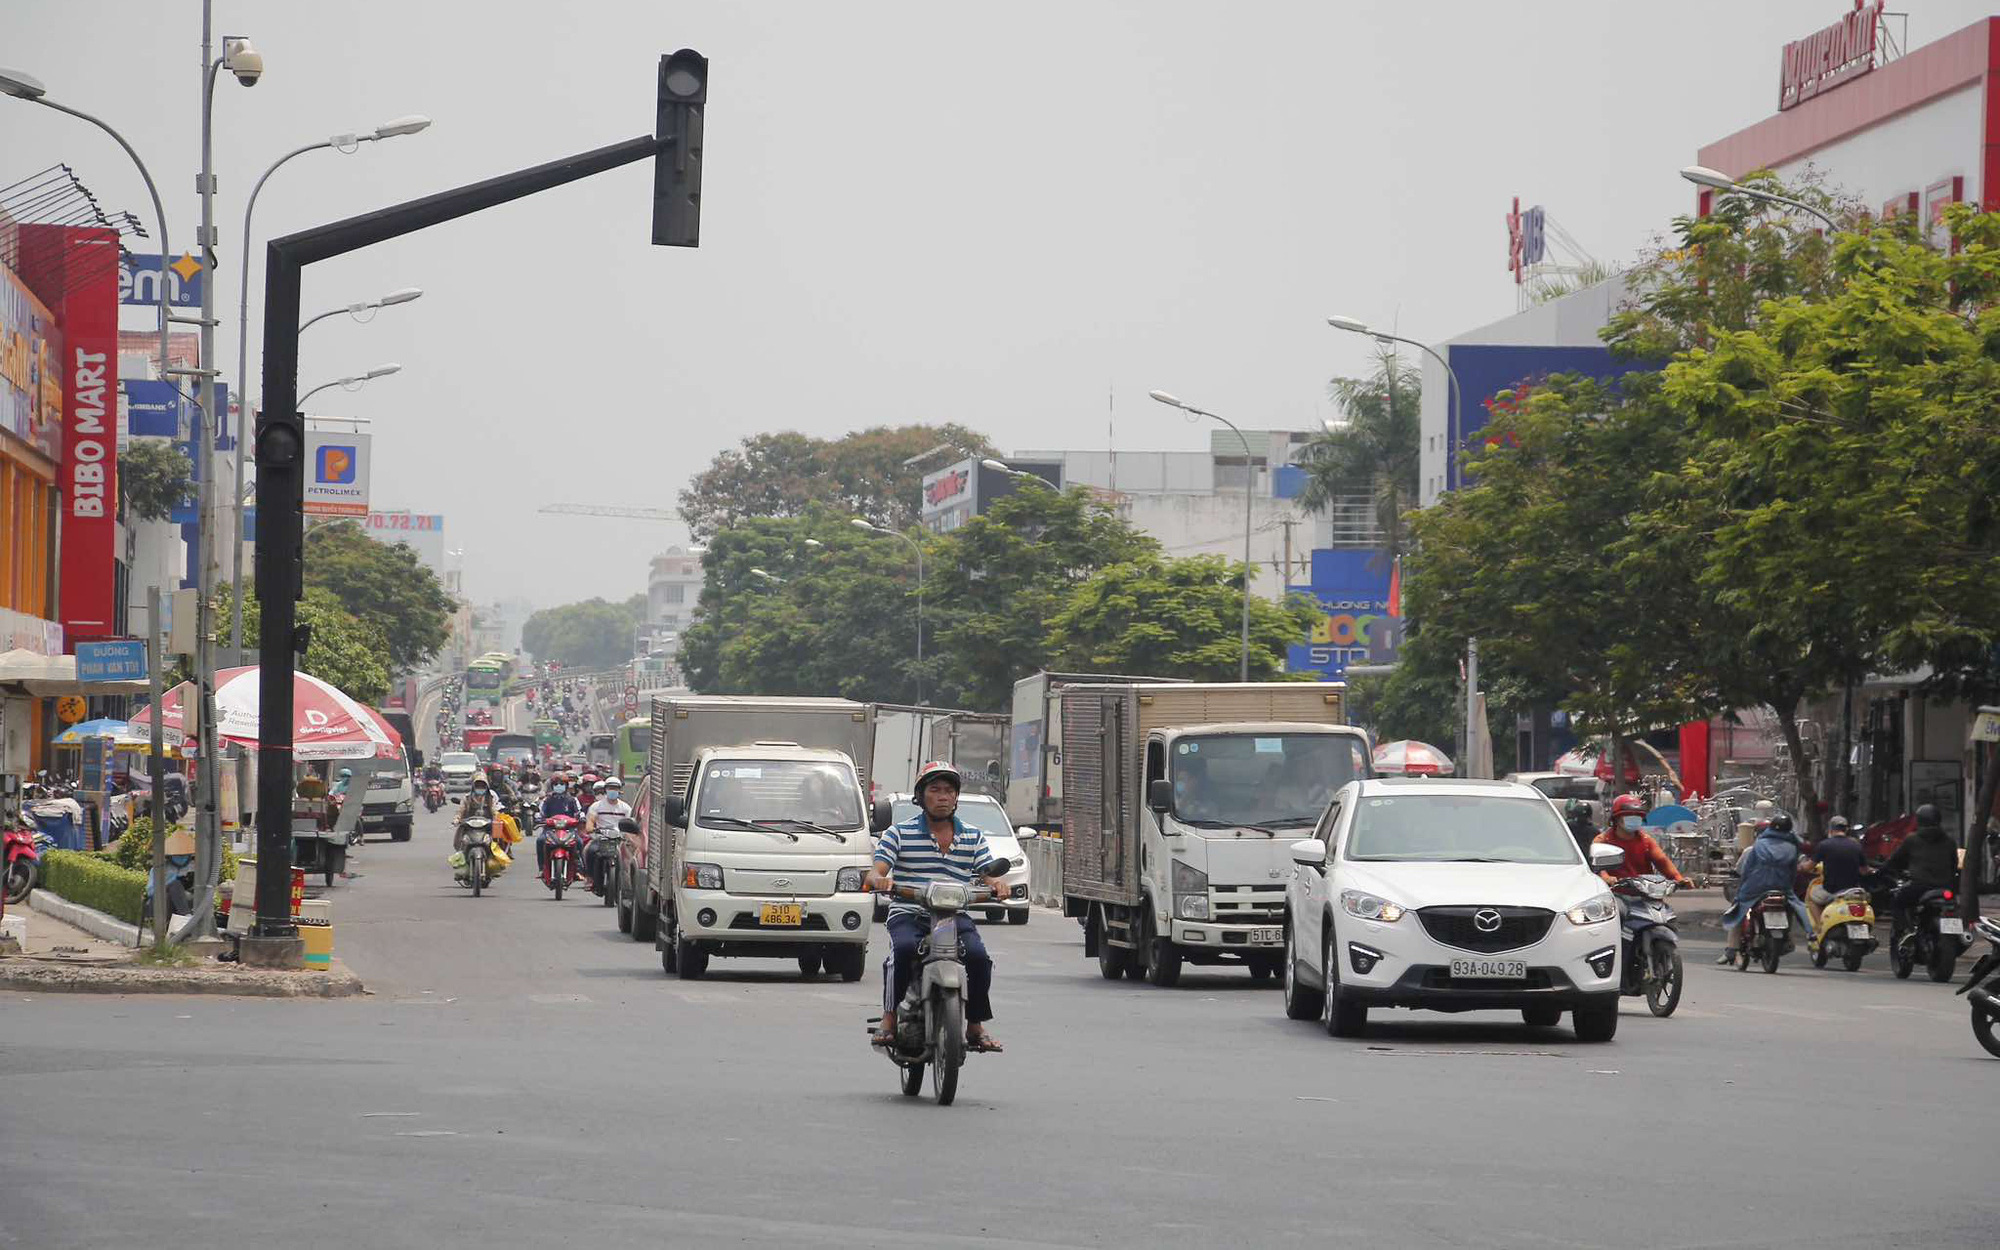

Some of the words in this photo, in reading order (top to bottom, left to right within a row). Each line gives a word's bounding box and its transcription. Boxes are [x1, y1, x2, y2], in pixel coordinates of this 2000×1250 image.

[75, 347, 106, 434] MART
[74, 439, 105, 517] BIBO
[308, 486, 362, 496] PETROLIMEX
[1453, 961, 1524, 976] 93A-049.28
